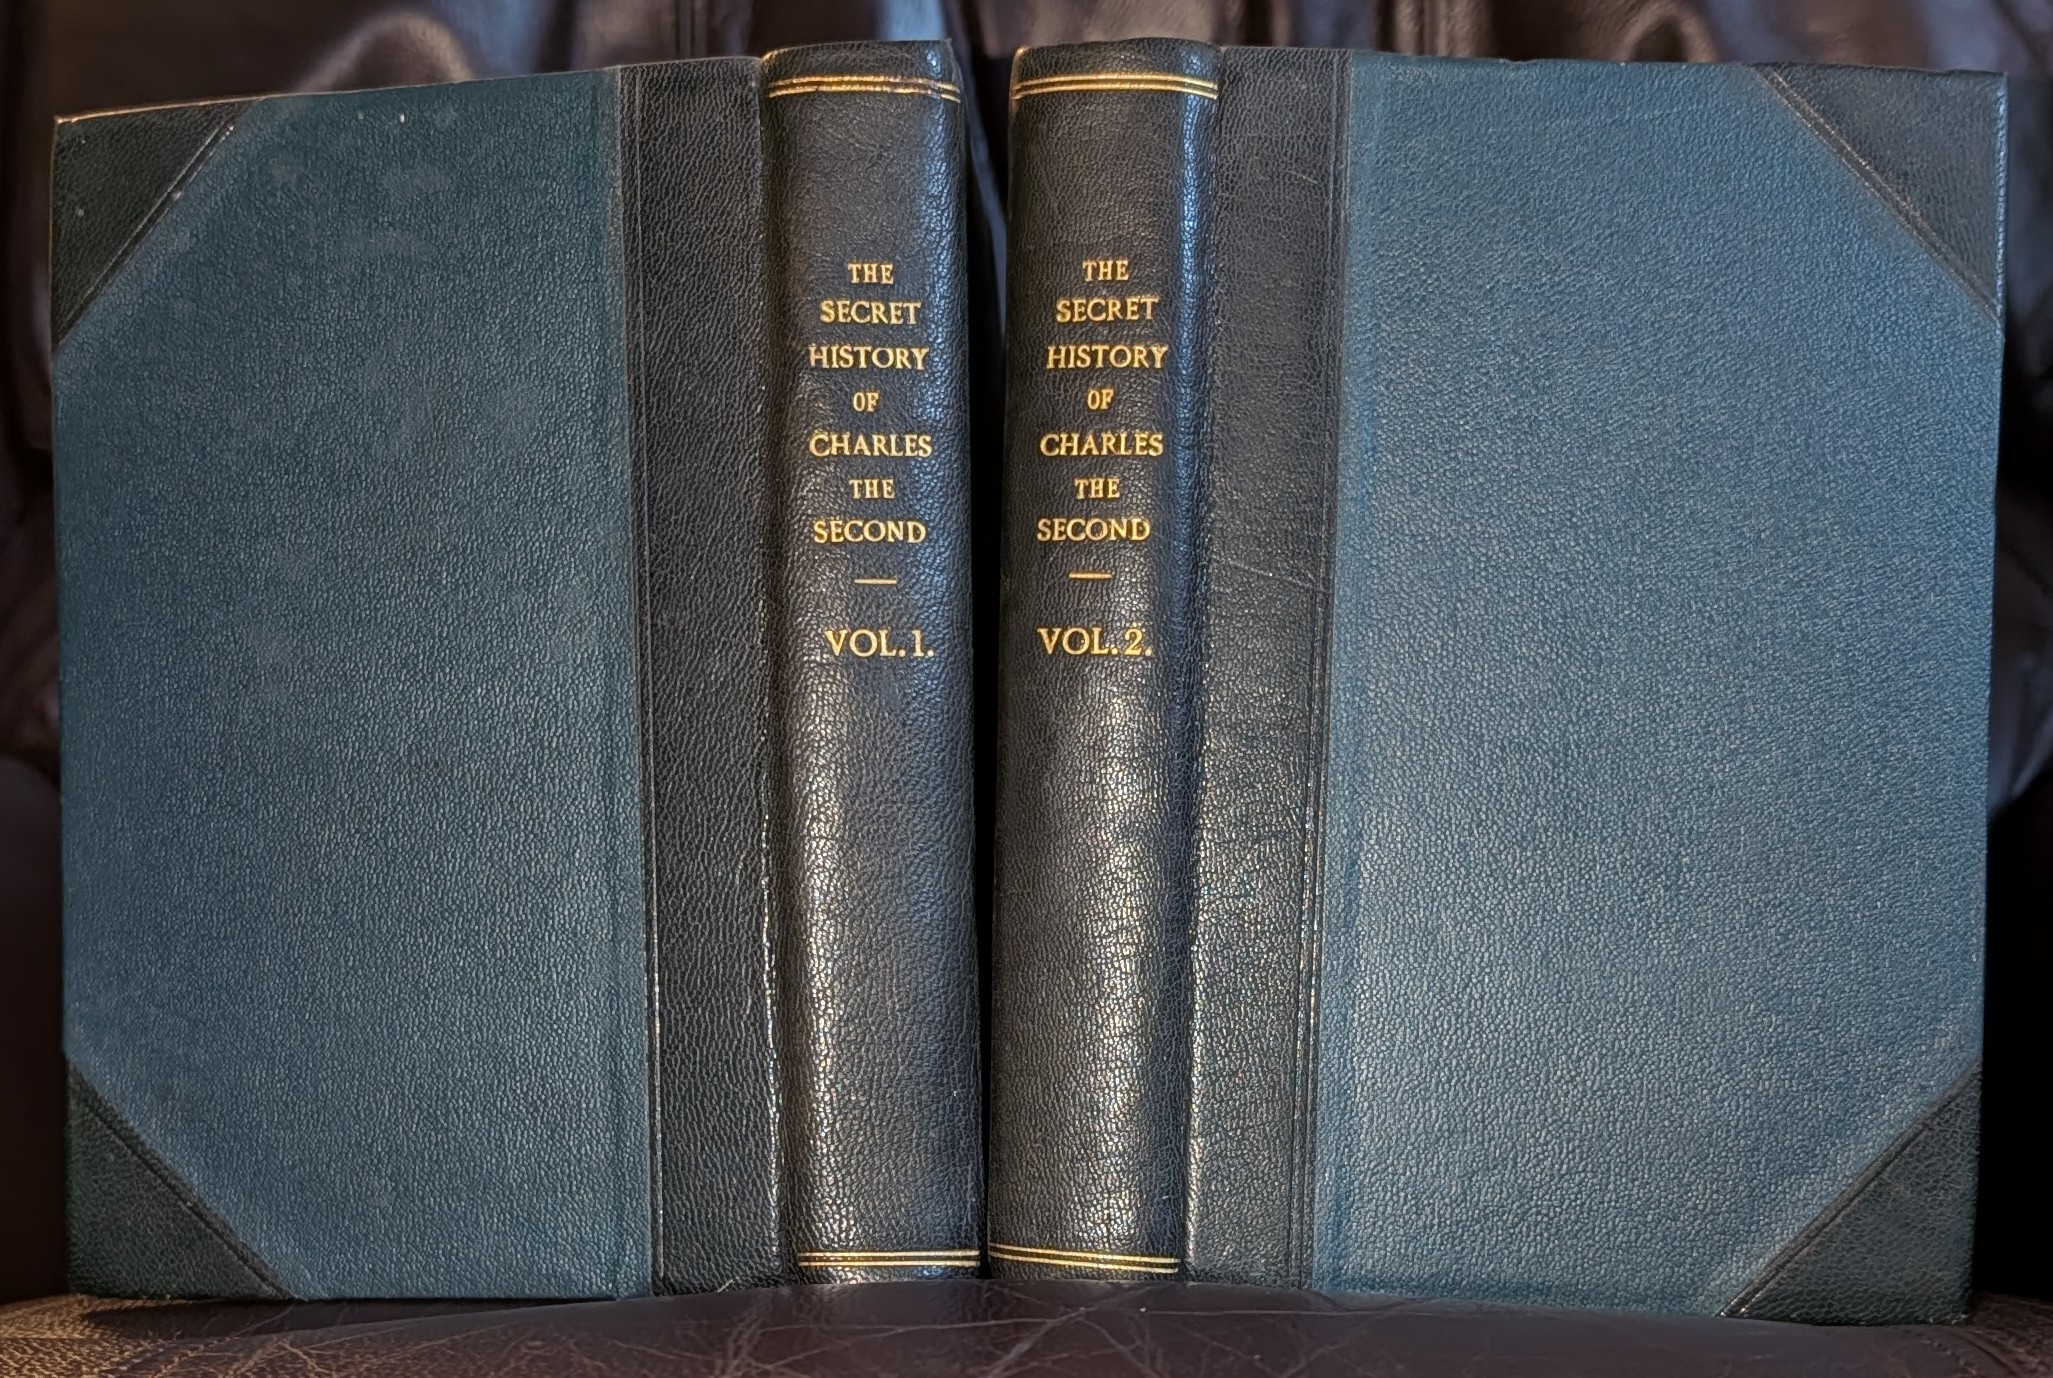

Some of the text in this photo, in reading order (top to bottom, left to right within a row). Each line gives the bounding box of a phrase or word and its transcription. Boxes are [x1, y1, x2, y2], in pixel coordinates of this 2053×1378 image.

[848, 262, 894, 285] THE
[1082, 259, 1130, 282] THE
[820, 300, 922, 325] SECRET
[1056, 297, 1159, 323] SECRET
[808, 345, 930, 370] HISTORY
[1046, 345, 1169, 369] HISTORY
[853, 392, 880, 412] OF
[1087, 389, 1115, 410] OF
[809, 433, 933, 458] CHARLES
[1040, 433, 1164, 457] CHARLES
[849, 479, 895, 499] THE
[1074, 478, 1120, 500] THE
[813, 520, 927, 544] SECOND
[1037, 518, 1151, 542] SECOND
